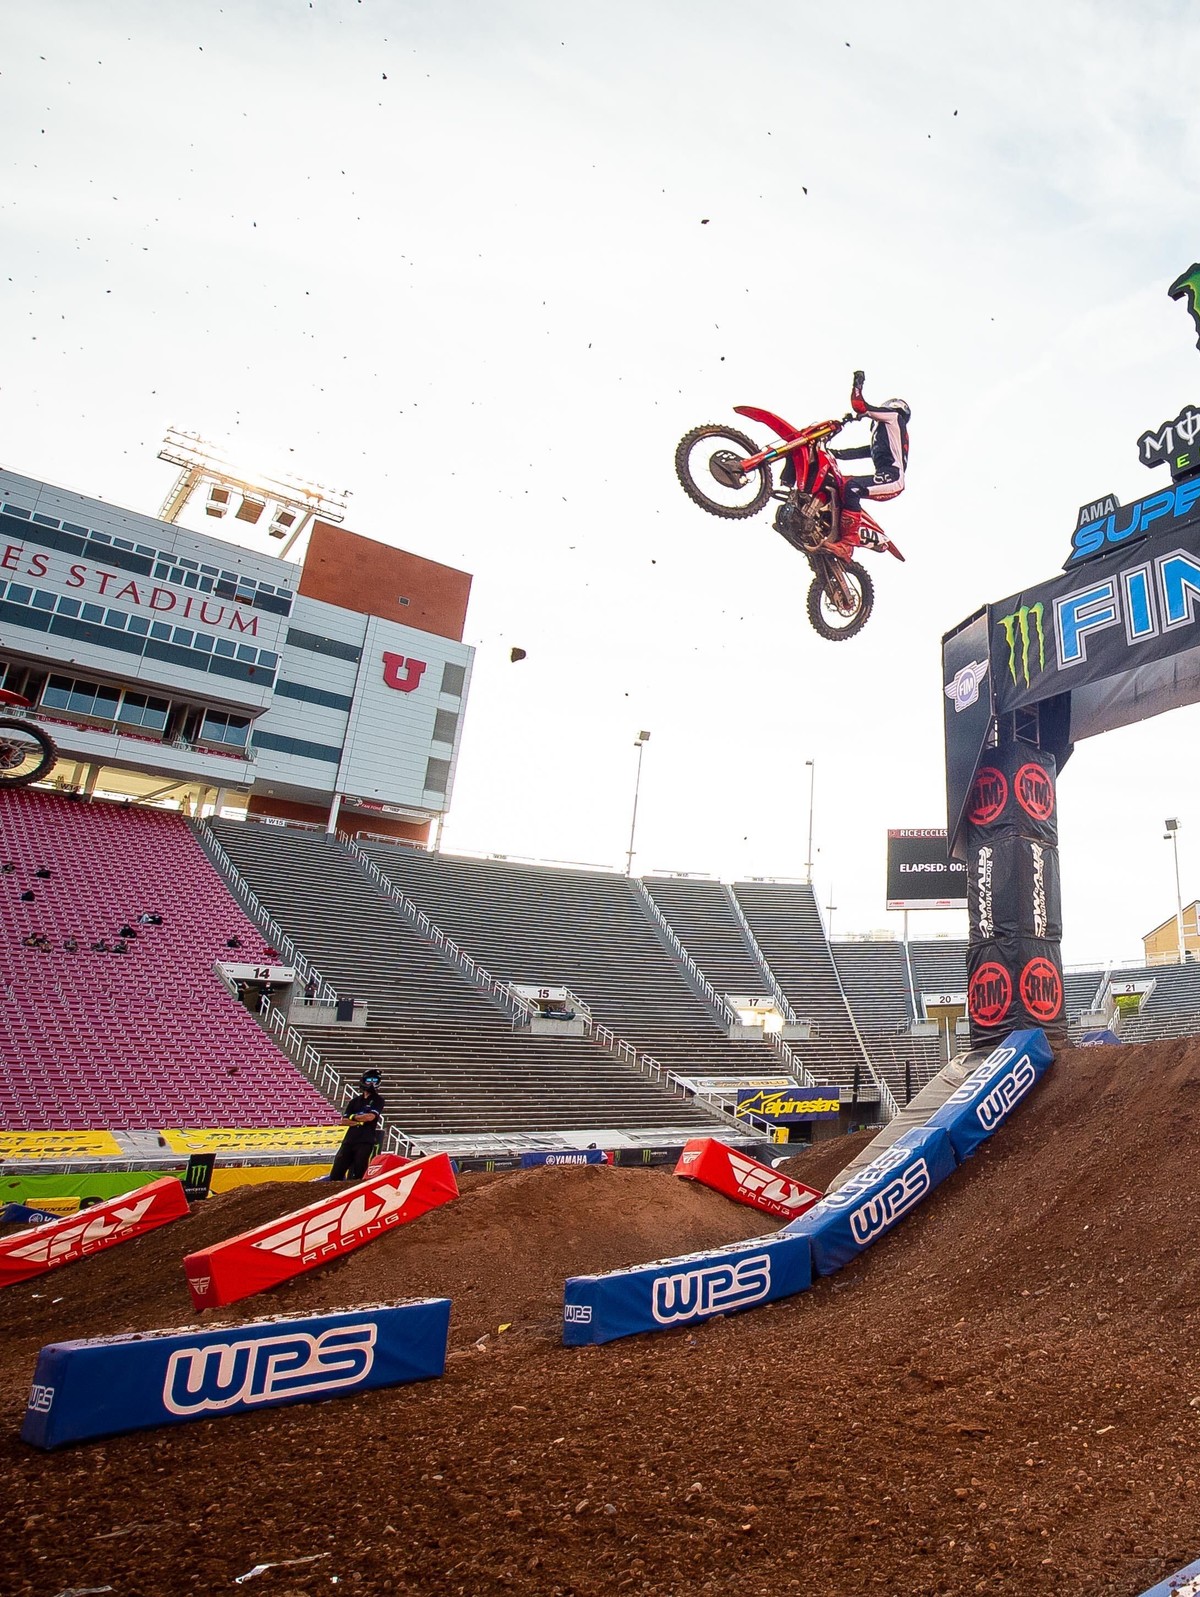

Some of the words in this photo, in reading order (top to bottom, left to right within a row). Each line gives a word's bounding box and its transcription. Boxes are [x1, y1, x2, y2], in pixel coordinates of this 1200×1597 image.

[1079, 496, 1116, 525] AMA
[65, 564, 260, 637] STADIUM
[382, 651, 427, 693] U
[957, 676, 976, 698] FIM
[267, 818, 286, 827] W15
[900, 829, 948, 837] RICE-ECCLES
[899, 863, 947, 873] ELAPSED:
[984, 860, 994, 889] ROCKY
[252, 968, 271, 980] 14
[1125, 983, 1136, 992] 21
[537, 989, 550, 999] 15
[748, 999, 760, 1007] 17
[939, 995, 951, 1004] 20
[949, 1047, 1017, 1104] WPS
[764, 1096, 840, 1118] alpinestars
[975, 1054, 1036, 1131] WPS
[555, 1155, 588, 1165] YAMAHA
[727, 1152, 817, 1209] FLY
[251, 1169, 423, 1258] FLY
[737, 1186, 791, 1216] RACING
[849, 1157, 930, 1245] WPS
[5, 1194, 157, 1263] FLY
[302, 1213, 400, 1265] RACING
[48, 1227, 134, 1267] RACING
[651, 1253, 771, 1324] WPS
[565, 1304, 592, 1325] WPS
[162, 1322, 379, 1416] WPS
[28, 1383, 55, 1413] WPS
